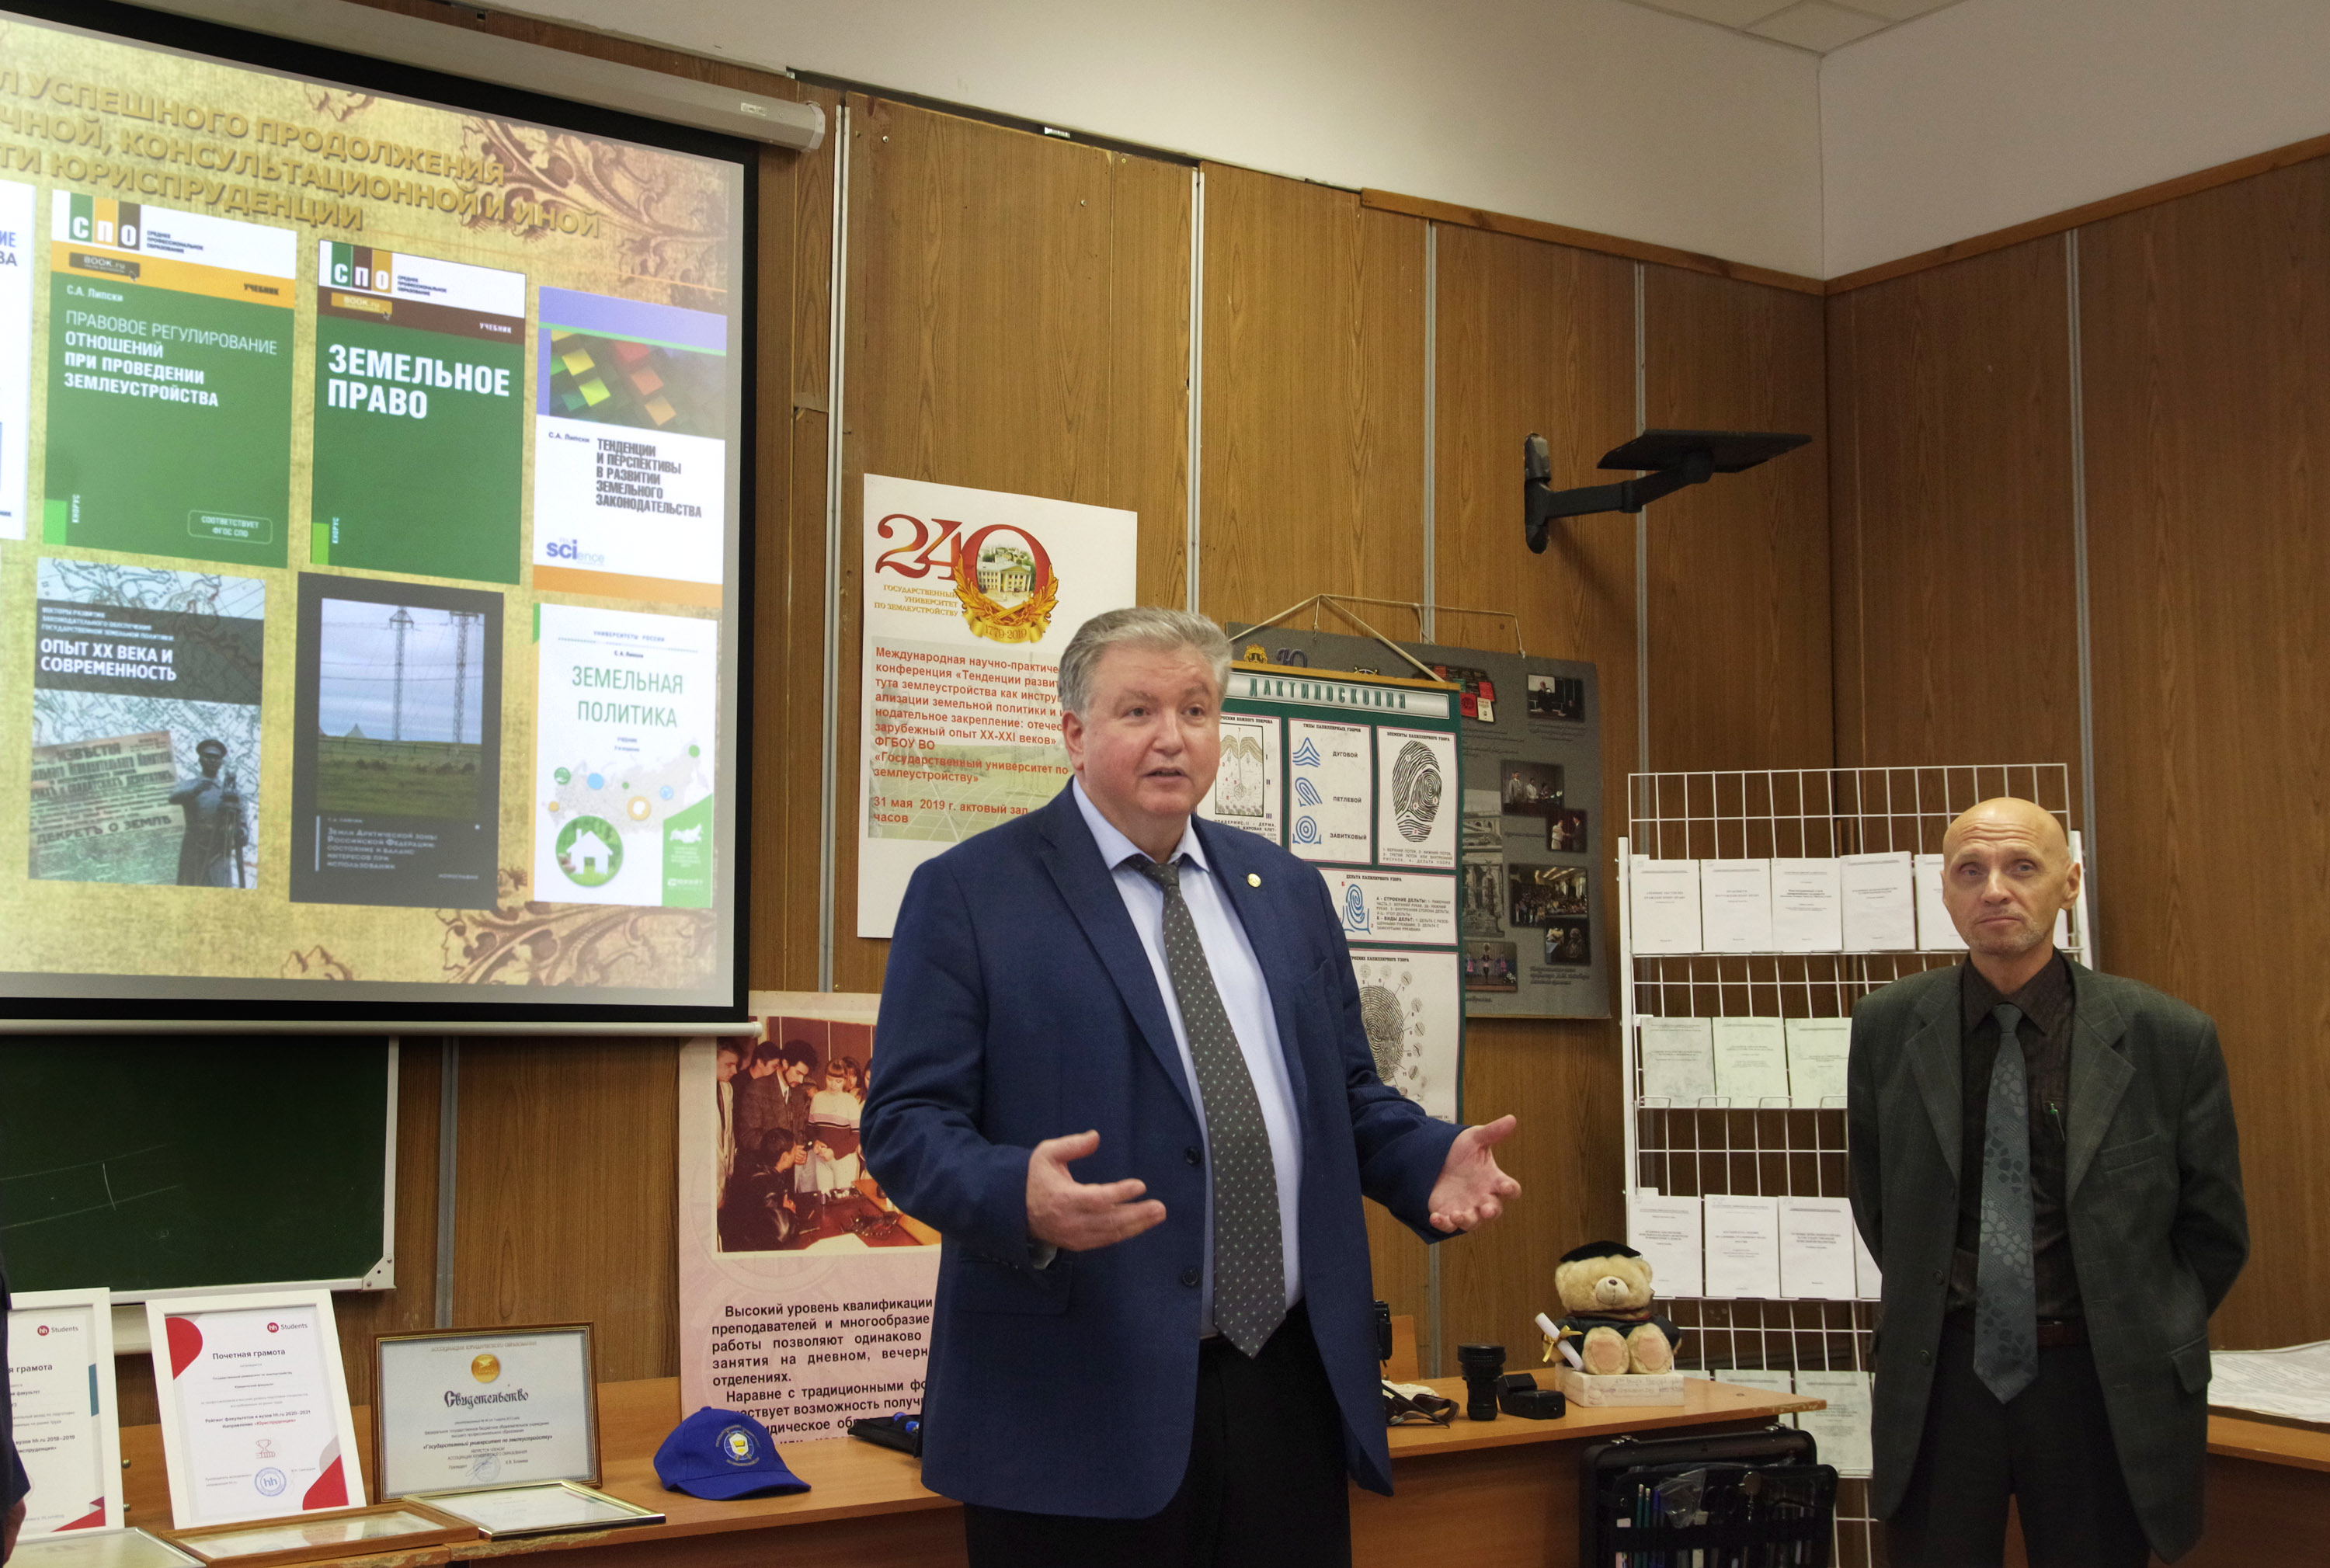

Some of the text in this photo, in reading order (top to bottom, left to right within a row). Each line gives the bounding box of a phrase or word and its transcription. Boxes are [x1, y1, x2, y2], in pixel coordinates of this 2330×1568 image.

[26, 72, 505, 187] УСПЕШНОГО ПРОДОЛЖЕНИЯ
[50, 153, 364, 231] ЮРИСПРУДЕНЦИИ
[120, 127, 477, 216] КОНСУЛЬТАЦИОННОЙ
[485, 196, 506, 221] И
[513, 199, 600, 238] ИНОЙ
[72, 216, 137, 247] СПО
[334, 262, 389, 290] СПО
[66, 310, 278, 356] ПРАВОВОЕ РЕГУЛИРОВАНИЕ
[479, 322, 512, 334] УЧЕБНИК
[65, 331, 164, 359] ОТНОШЕНИЙ
[64, 351, 205, 385] ПРИ ПРОВЕДЕНИИ
[328, 343, 510, 398] ЗЕМЕЛЬНОЕ
[64, 372, 219, 407] ЗЕМЛЕУСТРОЙСТВА
[328, 378, 427, 419] ПРАВО
[597, 438, 656, 458] ТЕНДЕНЦИИ
[596, 452, 682, 475] И ПЕРСПЕКТИВЫ
[596, 466, 661, 485] В РАЗВИТИИ
[596, 480, 663, 499] ЗЕМЕЛЬНОГО
[596, 493, 702, 518] ЗАКОНОДАТЕЛЬСТВА
[201, 514, 259, 529] СООТВЕТСТВУЕТ
[875, 513, 1054, 607] 240
[883, 584, 958, 599] ГОСУДАРСТВЕННЫЙ
[904, 596, 958, 608] УНИВЕРСИТЕТ
[887, 603, 958, 617] ЗЕМЛЕУСТРОЙСТВУ
[40, 638, 89, 656] ОПЫТ
[117, 645, 158, 663] ВЕКА
[162, 648, 173, 664] И
[876, 647, 1059, 675] Международная научно-практиче
[40, 655, 177, 682] СОВРЕМЕННОСТЬ
[876, 663, 1021, 685] конференция «Тенденции
[572, 665, 683, 695] ЗЕМЕЛЬНАЯ
[876, 678, 898, 689] тута
[902, 680, 996, 697] землеустройства
[1001, 688, 1017, 699] как
[1249, 676, 1407, 710] ДАКТИЛОСКОПИЯ
[577, 701, 678, 728] ПОЛИТИКА
[875, 693, 929, 707] ализации
[933, 696, 993, 712] земельной
[996, 703, 1046, 716] политики
[875, 708, 948, 723] нодательное
[951, 714, 1024, 729] закрепление:
[875, 723, 945, 738] зарубежный
[949, 729, 976, 740] опыт
[1019, 734, 1057, 746] веков»
[875, 735, 935, 751] ФГБОУ ВО
[875, 751, 1069, 775] «Государственный университет по
[874, 767, 979, 784] землеустройству»
[873, 796, 1028, 815] 31 мая 2019 г. актовый зал
[1333, 795, 1361, 804] ПЕТЛЕВОЙ
[109, 822, 120, 833] О
[873, 812, 909, 823] часов
[1330, 832, 1367, 841] ЗАВИТКОВЫЙ
[725, 1299, 933, 1318] Высокий уровень квалификации
[712, 1312, 930, 1335] преподавателей и многообразие
[712, 1332, 922, 1354] работы позволяют одинаково
[212, 1349, 286, 1360] Почетная грамота
[712, 1347, 928, 1370] занятия на дневном, вечерн
[16, 1364, 53, 1374] грамота
[712, 1372, 792, 1388] отделениях.
[443, 1388, 529, 1410] Свидетельство
[726, 1389, 782, 1404] Наравне
[788, 1389, 795, 1399] с
[802, 1382, 904, 1398] традиционными
[794, 1398, 923, 1416] возможность получ
[263, 1476, 278, 1487] hh
